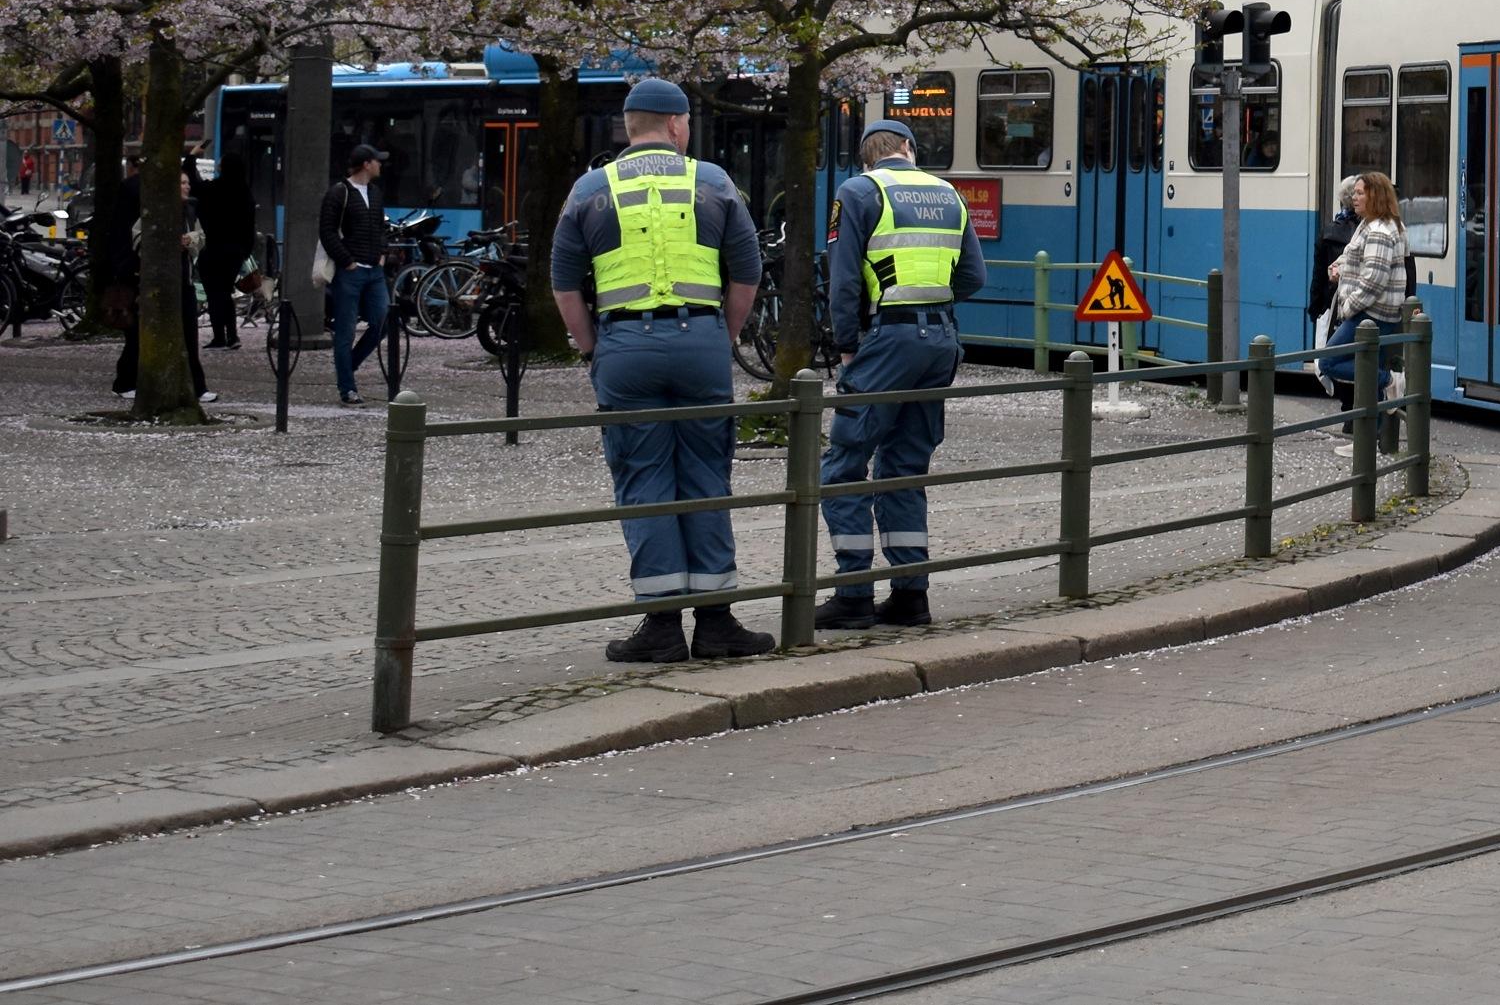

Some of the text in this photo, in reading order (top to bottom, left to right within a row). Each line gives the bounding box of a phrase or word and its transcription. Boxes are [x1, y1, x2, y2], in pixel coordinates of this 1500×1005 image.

[619, 155, 684, 171] ORDNINGS
[635, 165, 668, 176] VAKT
[894, 191, 956, 205] ORDNINGS
[914, 207, 944, 221] VAKT
